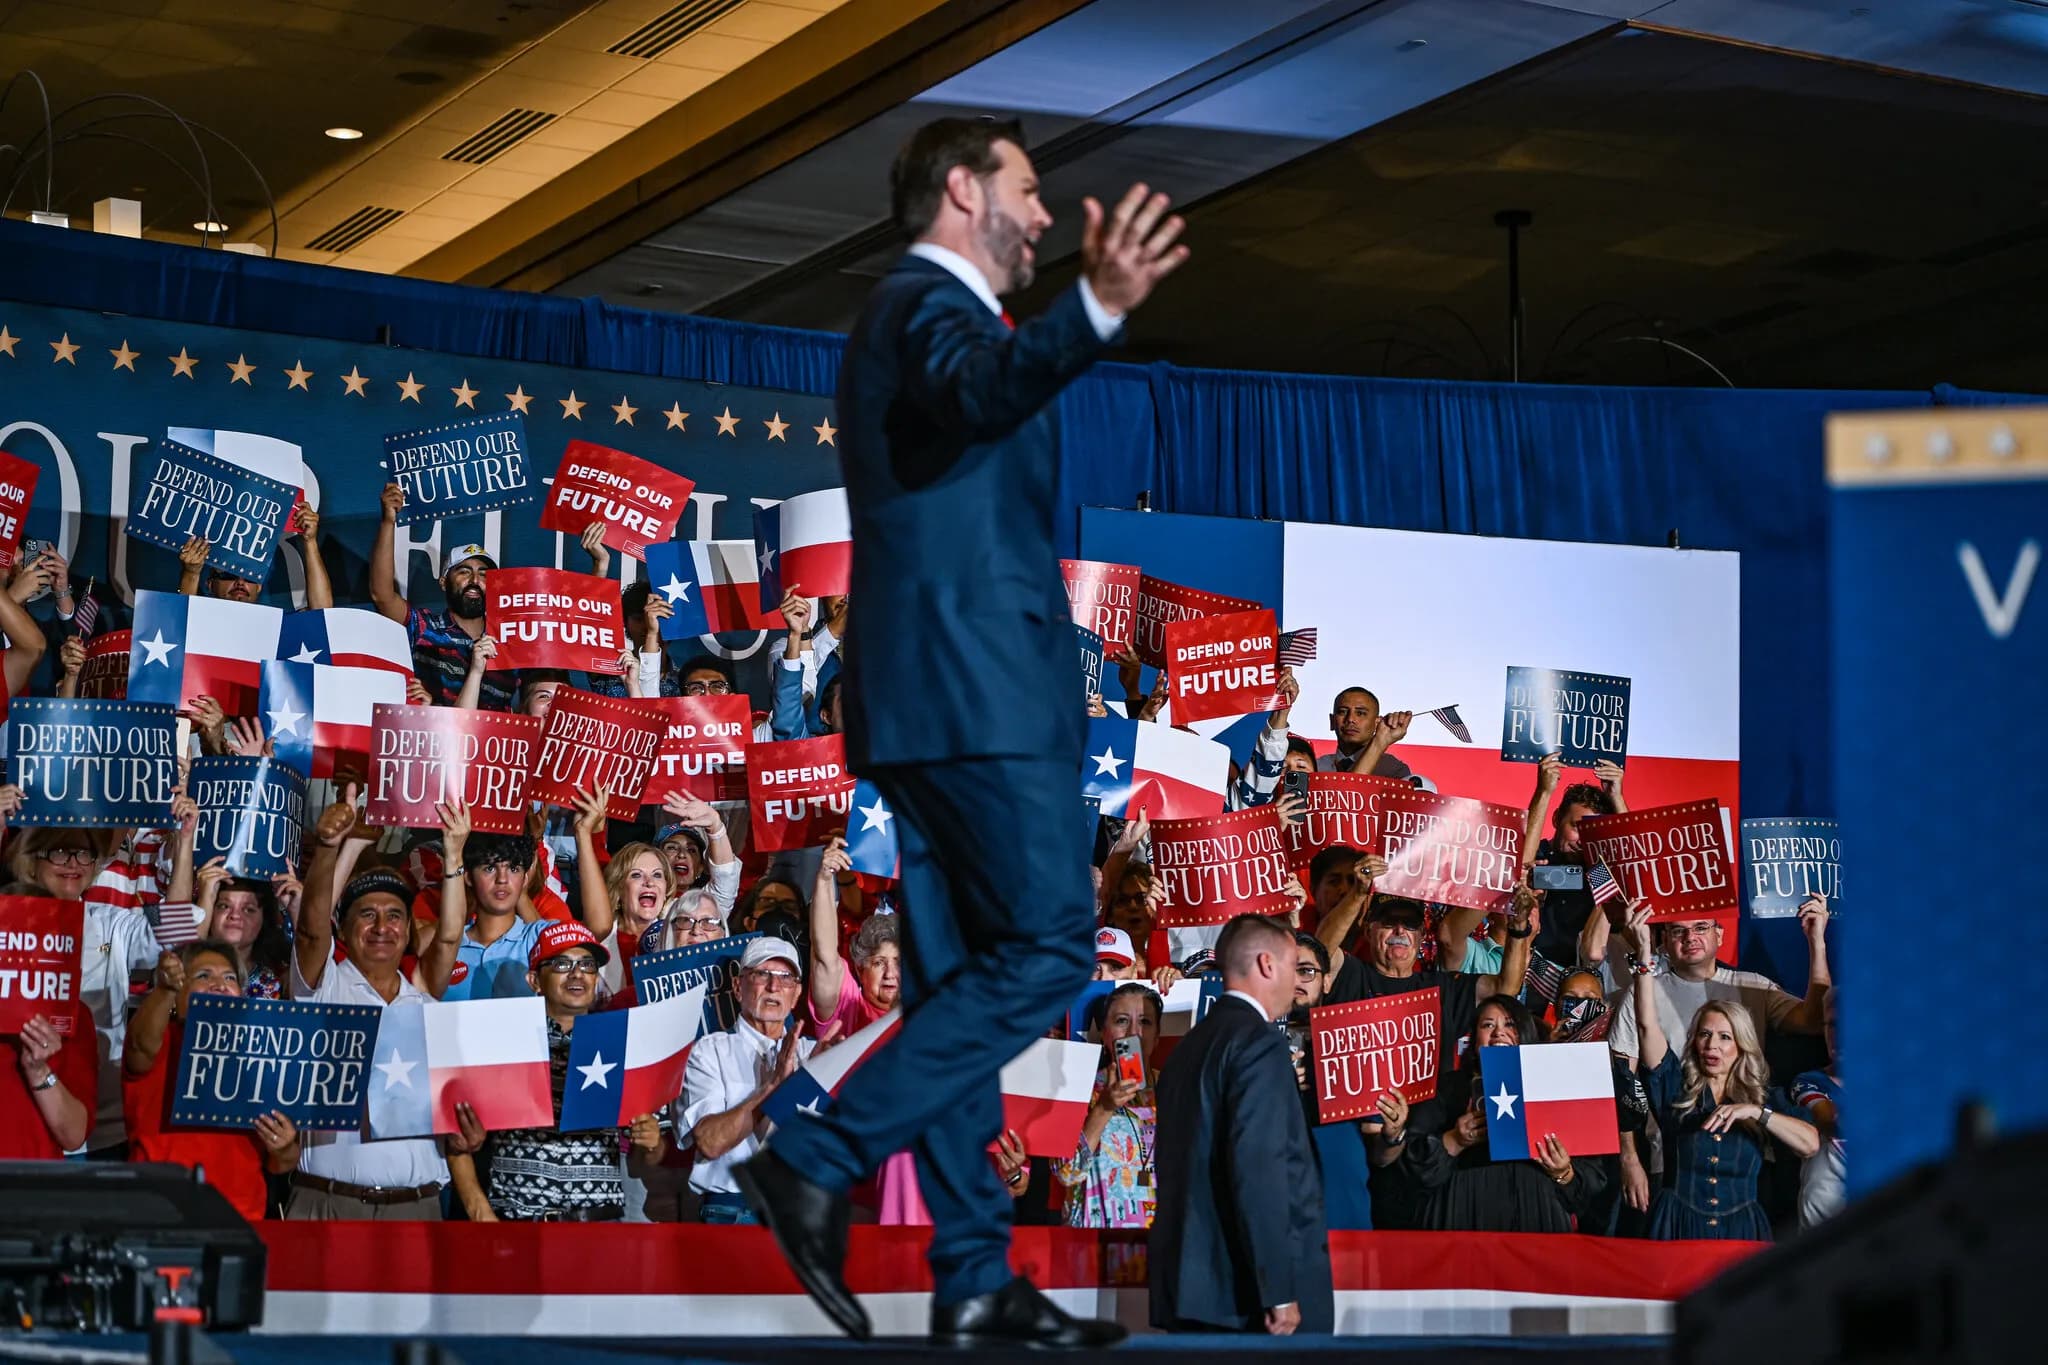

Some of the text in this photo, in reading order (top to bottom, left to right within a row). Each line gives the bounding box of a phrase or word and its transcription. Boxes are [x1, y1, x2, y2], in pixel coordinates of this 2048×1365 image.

[392, 430, 520, 472] DEFEND OUR
[154, 458, 282, 527] DEFEND OUR
[393, 453, 527, 507] FUTURE
[567, 463, 673, 511] DEFEND OUR
[137, 482, 275, 563] FUTURE
[556, 487, 663, 540] FUTURE
[499, 593, 613, 616] DEFEND OUR
[1094, 581, 1132, 607] OUR
[500, 620, 615, 649] FUTURE
[1071, 602, 1132, 643] URE
[1080, 647, 1098, 677] UR
[1177, 635, 1273, 662] DEFEND OUR
[1179, 663, 1277, 698] FUTURE
[1590, 693, 1625, 718] OUR
[18, 723, 173, 757] DEFEND OUR
[551, 709, 621, 748] DEFEND
[623, 727, 657, 759] OUR
[703, 722, 742, 738] OUR
[1508, 709, 1624, 753] FUTURE
[485, 736, 529, 767] OUR
[532, 737, 650, 800] FUTURE
[650, 751, 745, 777] TURE
[16, 755, 176, 804] FUTURE
[374, 758, 528, 811] FUTURE
[761, 764, 840, 786] DEFEND
[196, 780, 303, 824] DEFEND OUR
[765, 788, 855, 823] FUTU
[193, 809, 302, 868] FUTURE
[1157, 825, 1282, 867] DEFEND OUR
[1290, 811, 1378, 852] FUTU
[1475, 823, 1519, 854] OUR
[1586, 822, 1719, 866] DEFEND OUR
[1750, 837, 1827, 861] DEFEND
[1159, 851, 1287, 908] FUTURE
[1382, 835, 1517, 893] FUTURE
[1751, 861, 1846, 900] FUTUR
[43, 933, 74, 953] OUR
[0, 969, 71, 1001] TURE
[642, 964, 723, 1004] DEFEND
[192, 1021, 366, 1060] DEFEND OUR
[1319, 1019, 1398, 1057] DEFEND
[1402, 1011, 1436, 1042] OUR
[182, 1053, 363, 1107] FUTURE
[1320, 1038, 1436, 1100] FUTURE
